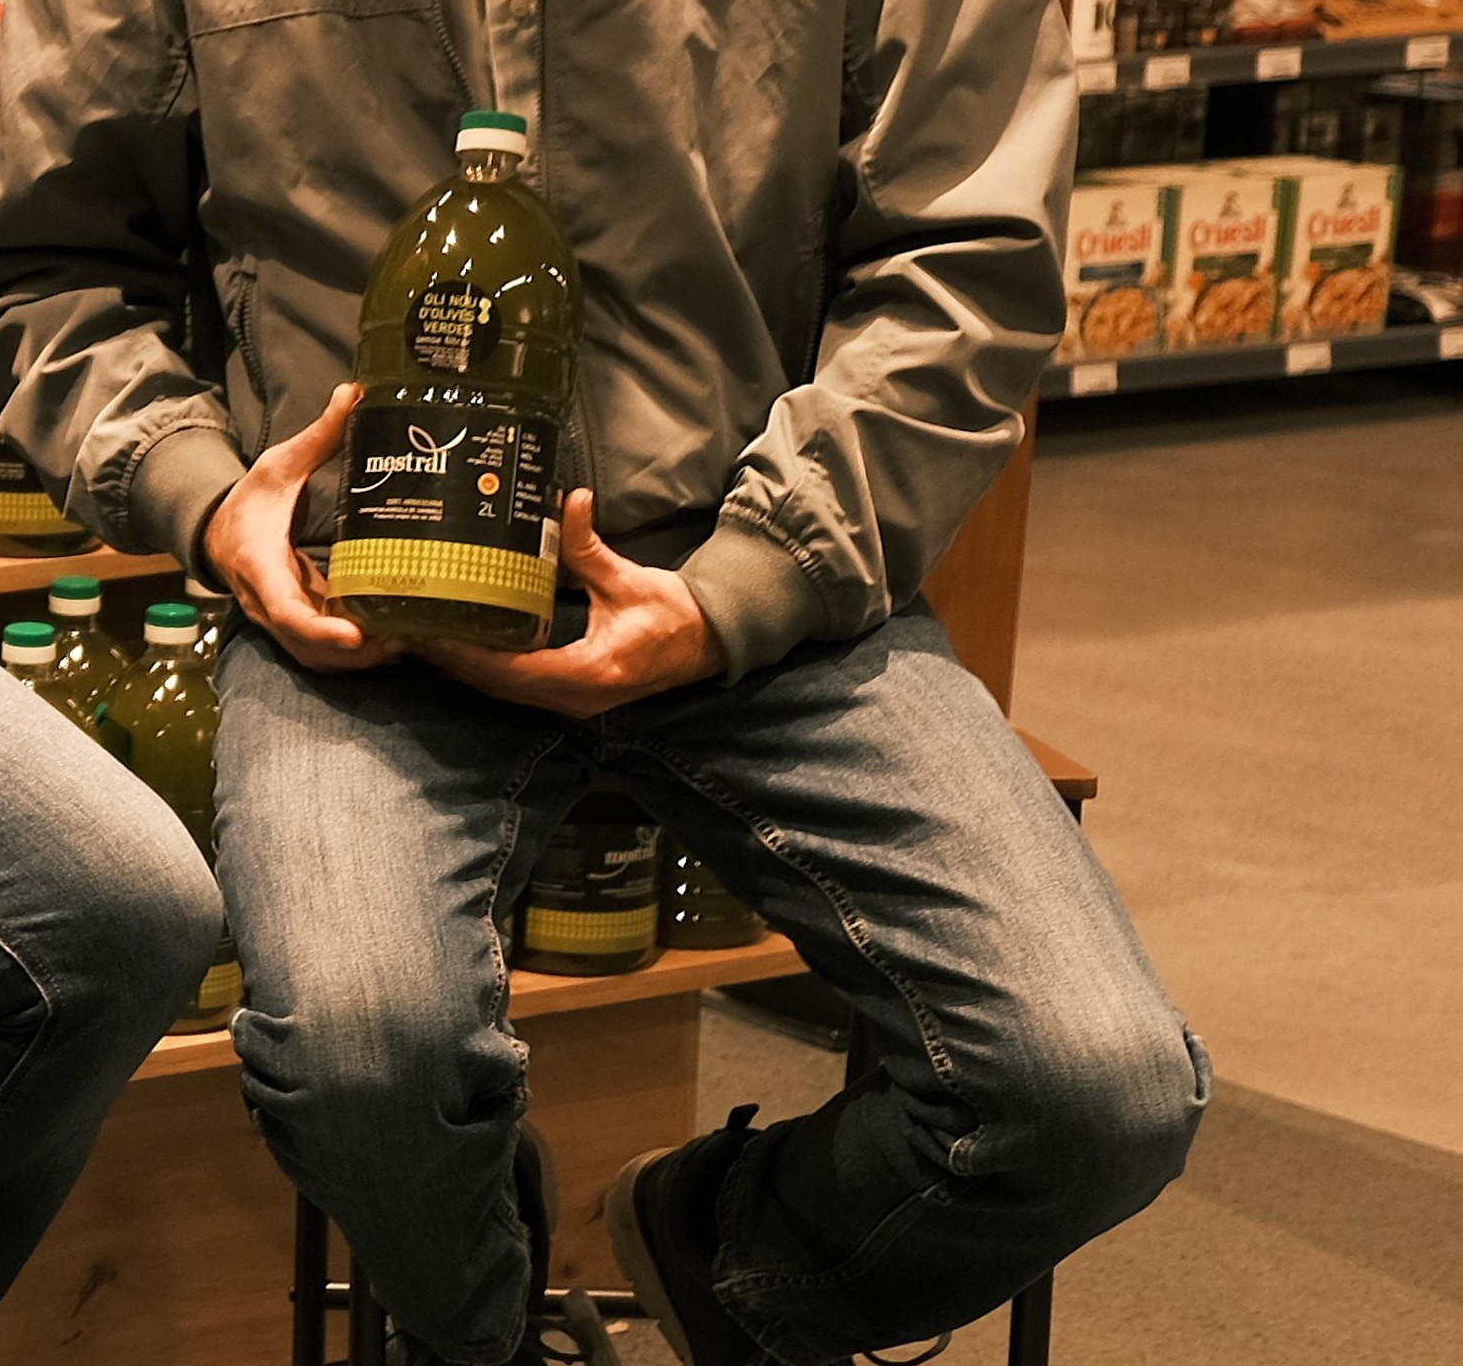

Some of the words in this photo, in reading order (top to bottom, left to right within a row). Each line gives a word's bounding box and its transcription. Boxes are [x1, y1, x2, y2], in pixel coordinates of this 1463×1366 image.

[424, 293, 445, 305] OLI
[449, 294, 478, 308] NOU
[364, 450, 448, 475] mestral
[478, 500, 498, 520] 2L
